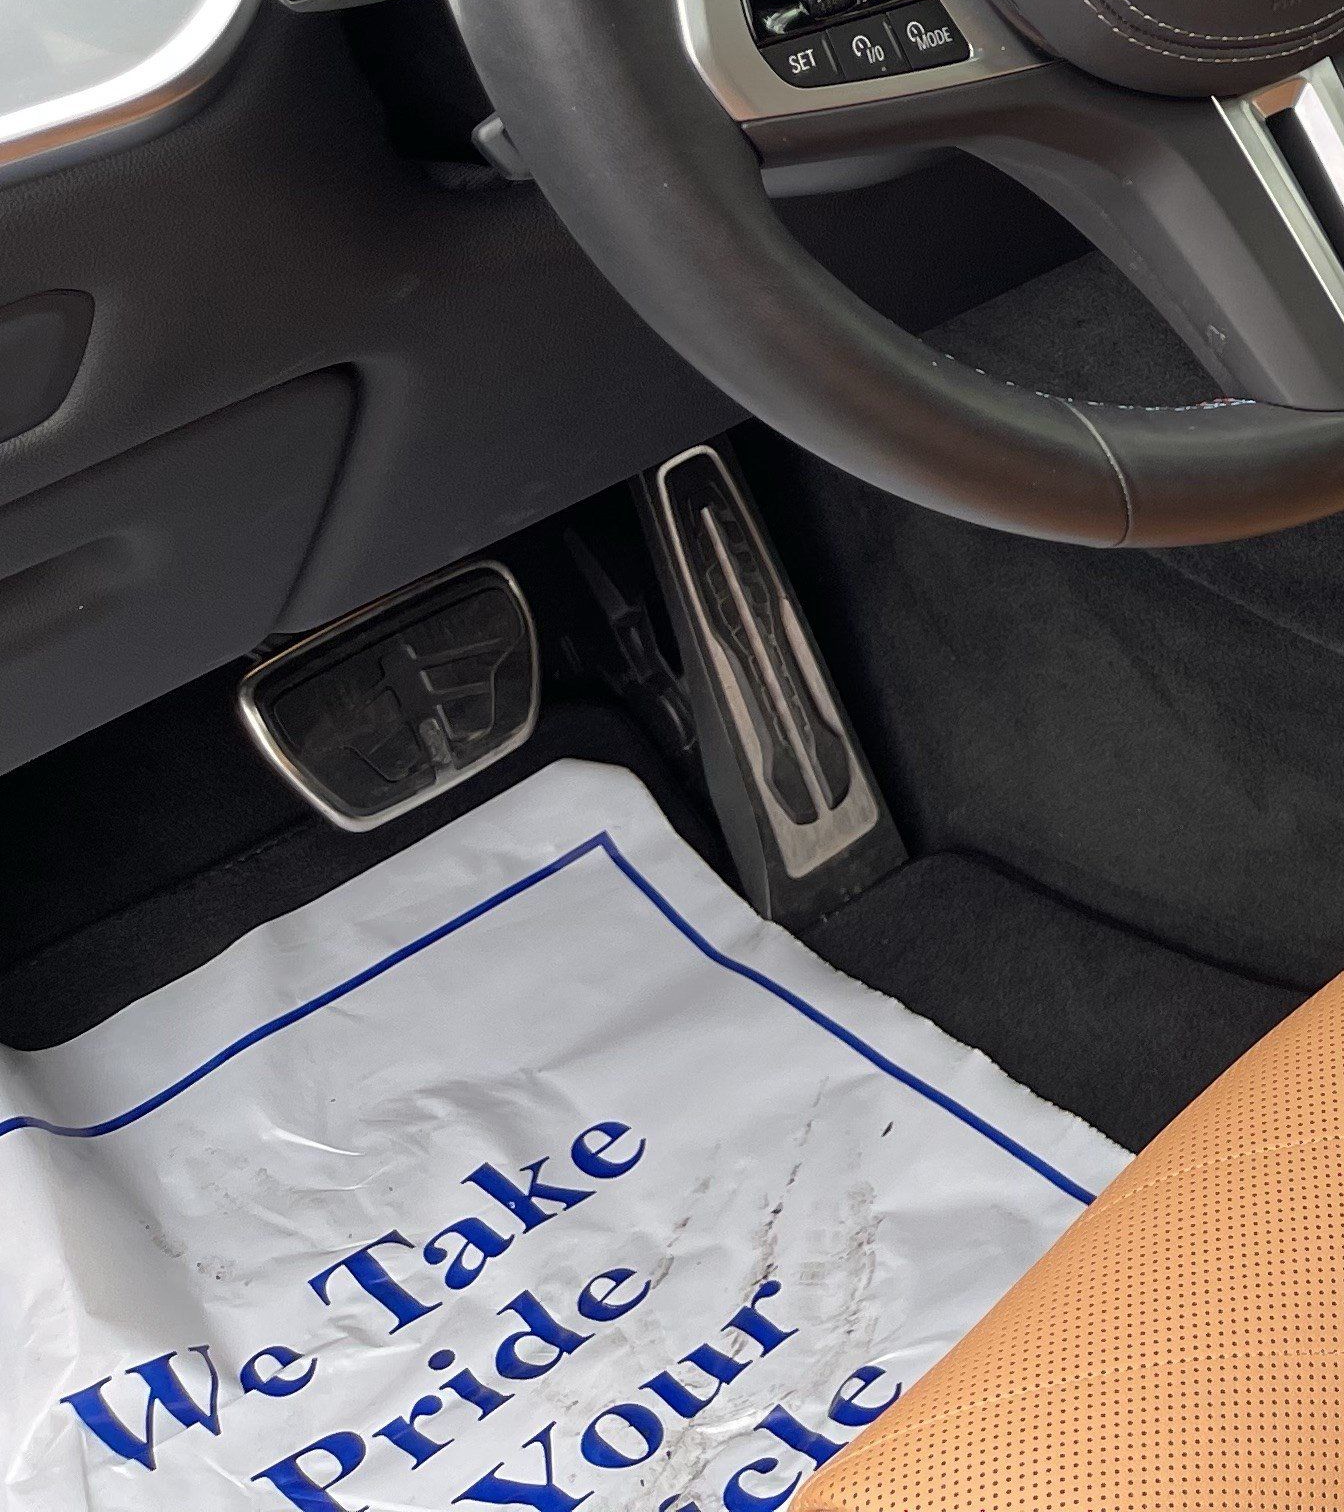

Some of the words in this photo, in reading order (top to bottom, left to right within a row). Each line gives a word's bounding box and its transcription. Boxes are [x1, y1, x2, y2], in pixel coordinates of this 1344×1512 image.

[788, 49, 817, 74] SET
[916, 26, 955, 51] MODE
[61, 1344, 317, 1472] We
[309, 1119, 648, 1336] Take
[250, 1265, 652, 1512] Pride
[450, 1279, 799, 1512] Your
